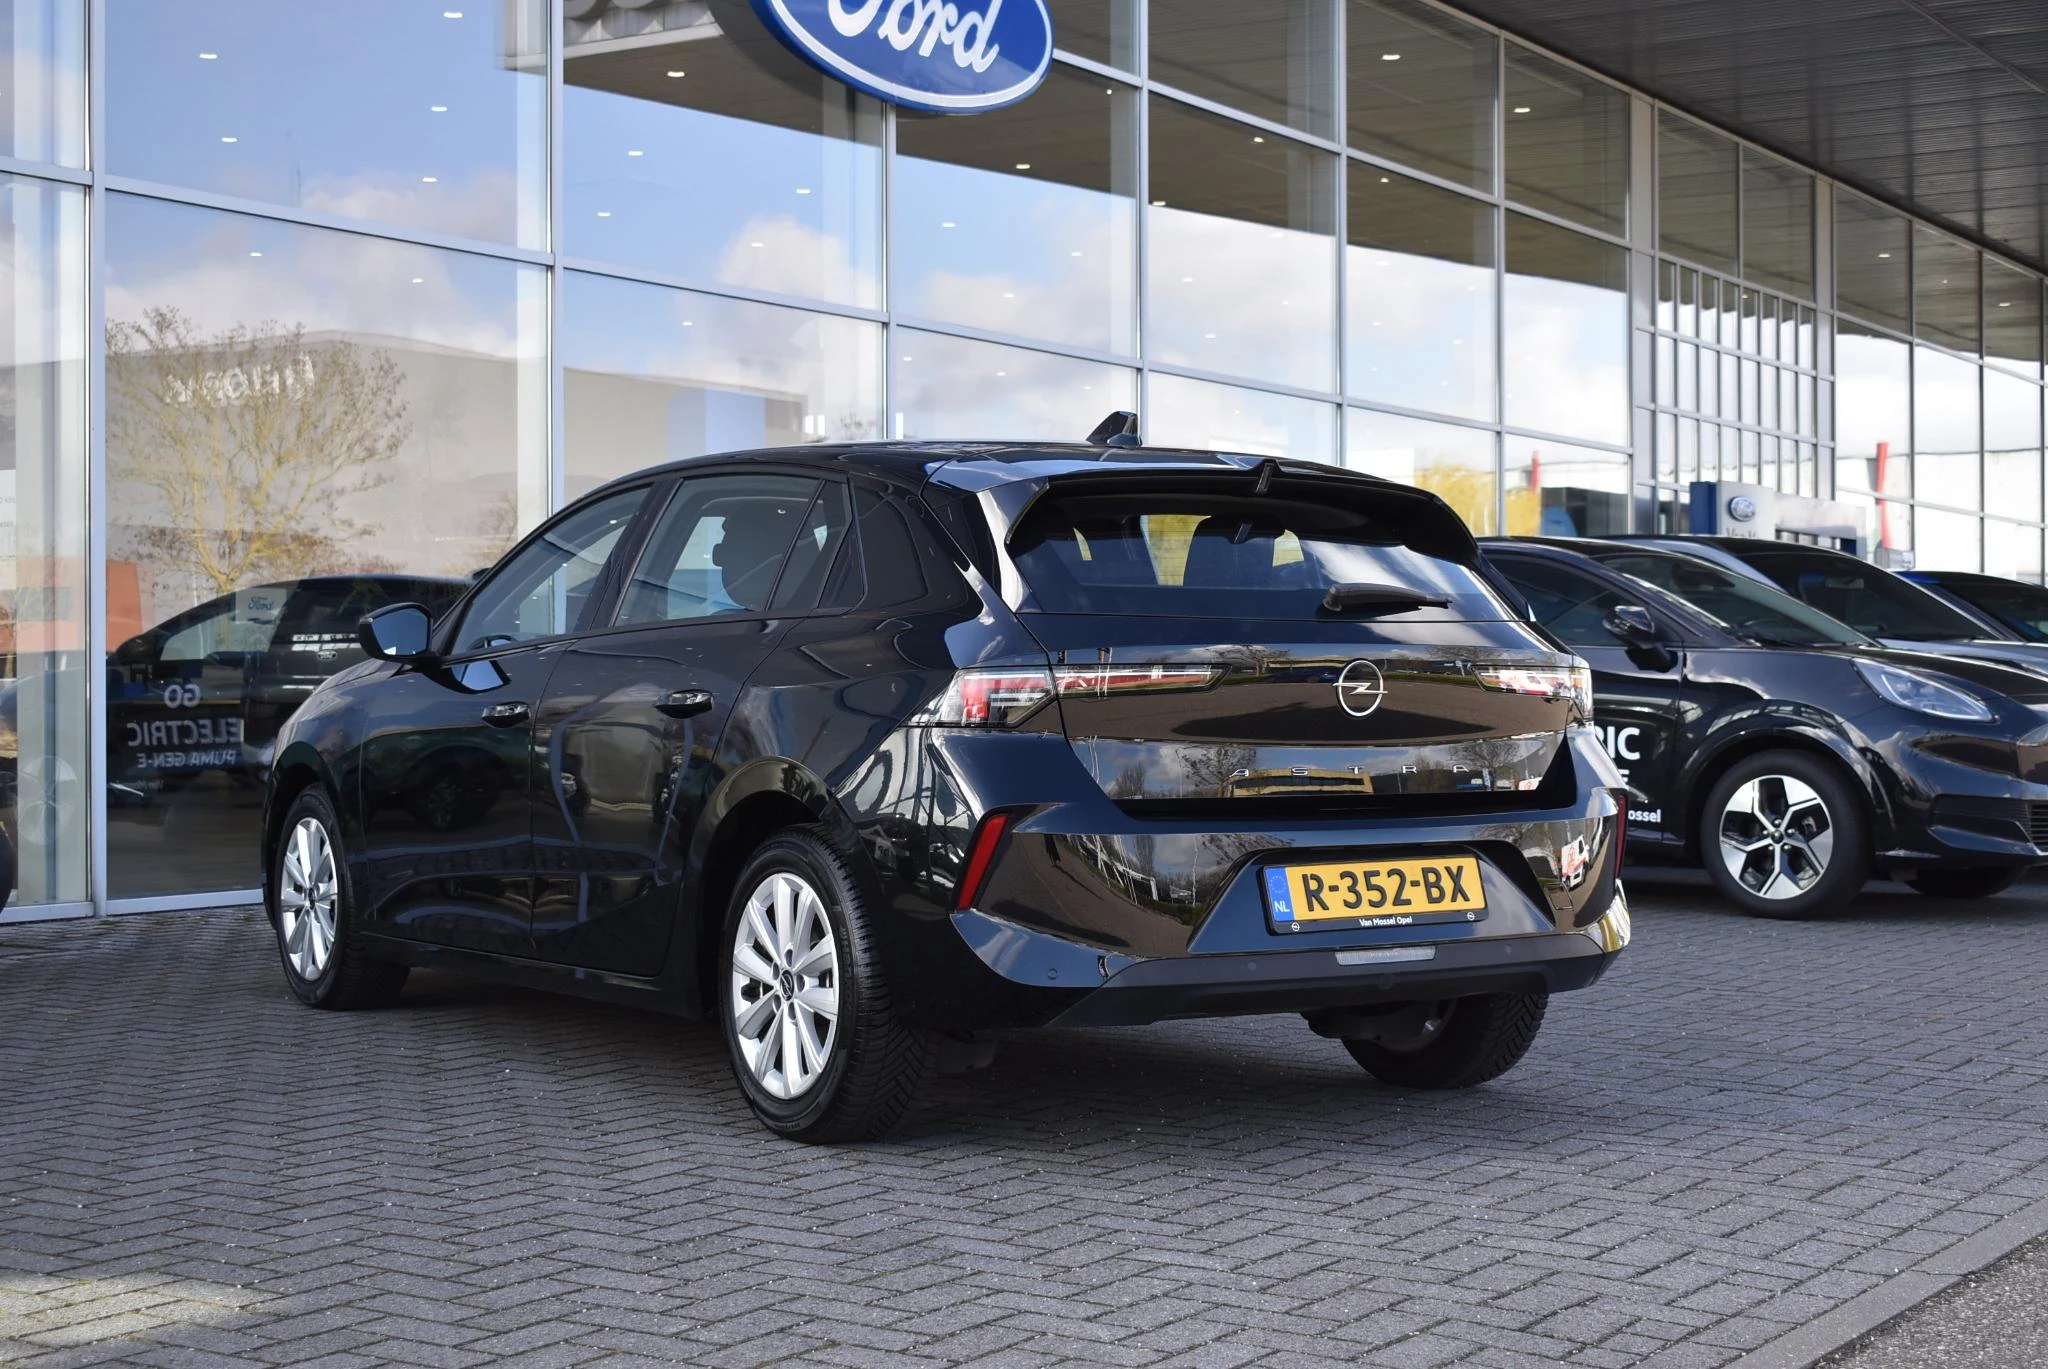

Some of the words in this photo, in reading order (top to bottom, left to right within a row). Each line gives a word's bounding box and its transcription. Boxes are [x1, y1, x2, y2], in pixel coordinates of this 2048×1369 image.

[1230, 765, 1470, 777] ASTRA
[1302, 865, 1471, 912] R-352-BX
[1274, 900, 1291, 914] NL
[1358, 918, 1373, 927] Van
[1373, 916, 1396, 926] Mossel
[1396, 915, 1413, 925] Opel
